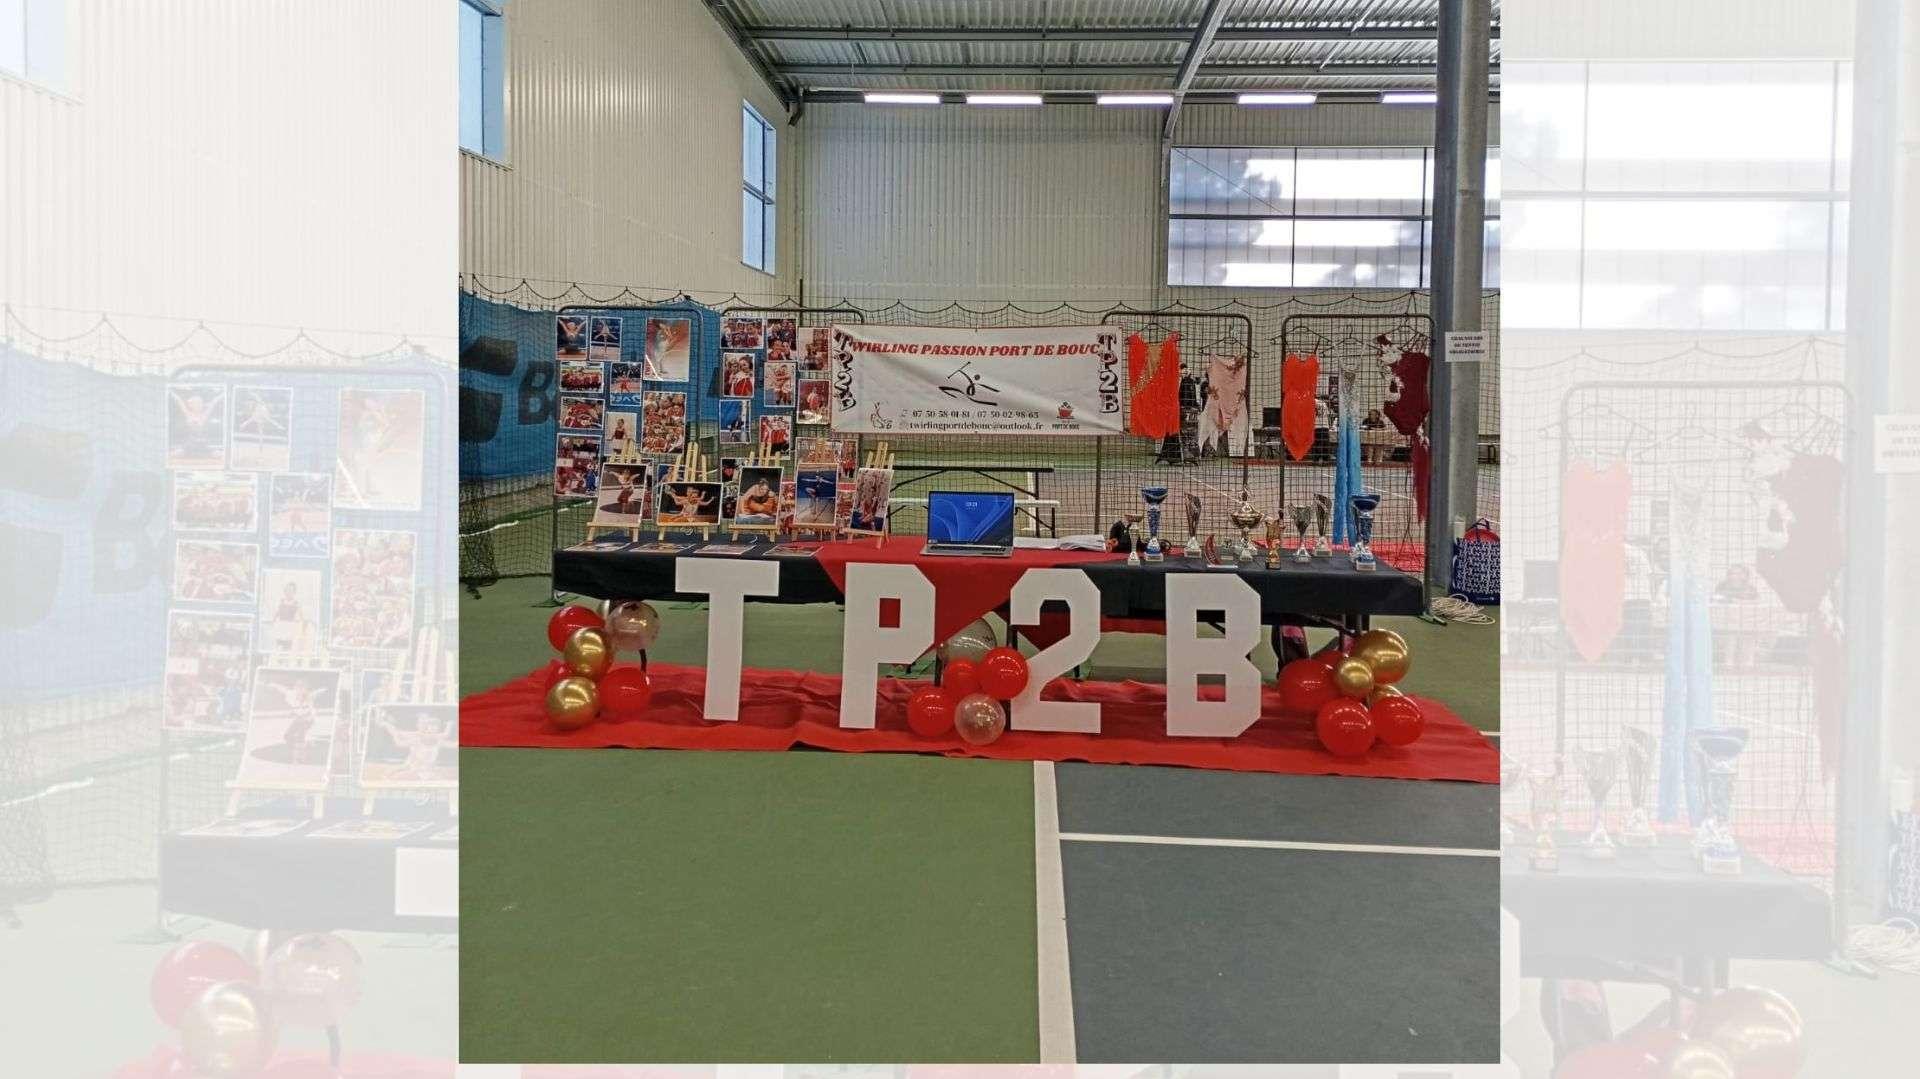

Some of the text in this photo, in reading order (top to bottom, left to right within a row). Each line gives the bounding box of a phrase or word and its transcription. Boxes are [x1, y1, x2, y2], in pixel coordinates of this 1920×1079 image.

[850, 341, 1100, 356] WIRLING PASSION PORT DE BOUC
[1098, 333, 1120, 414] TP2B
